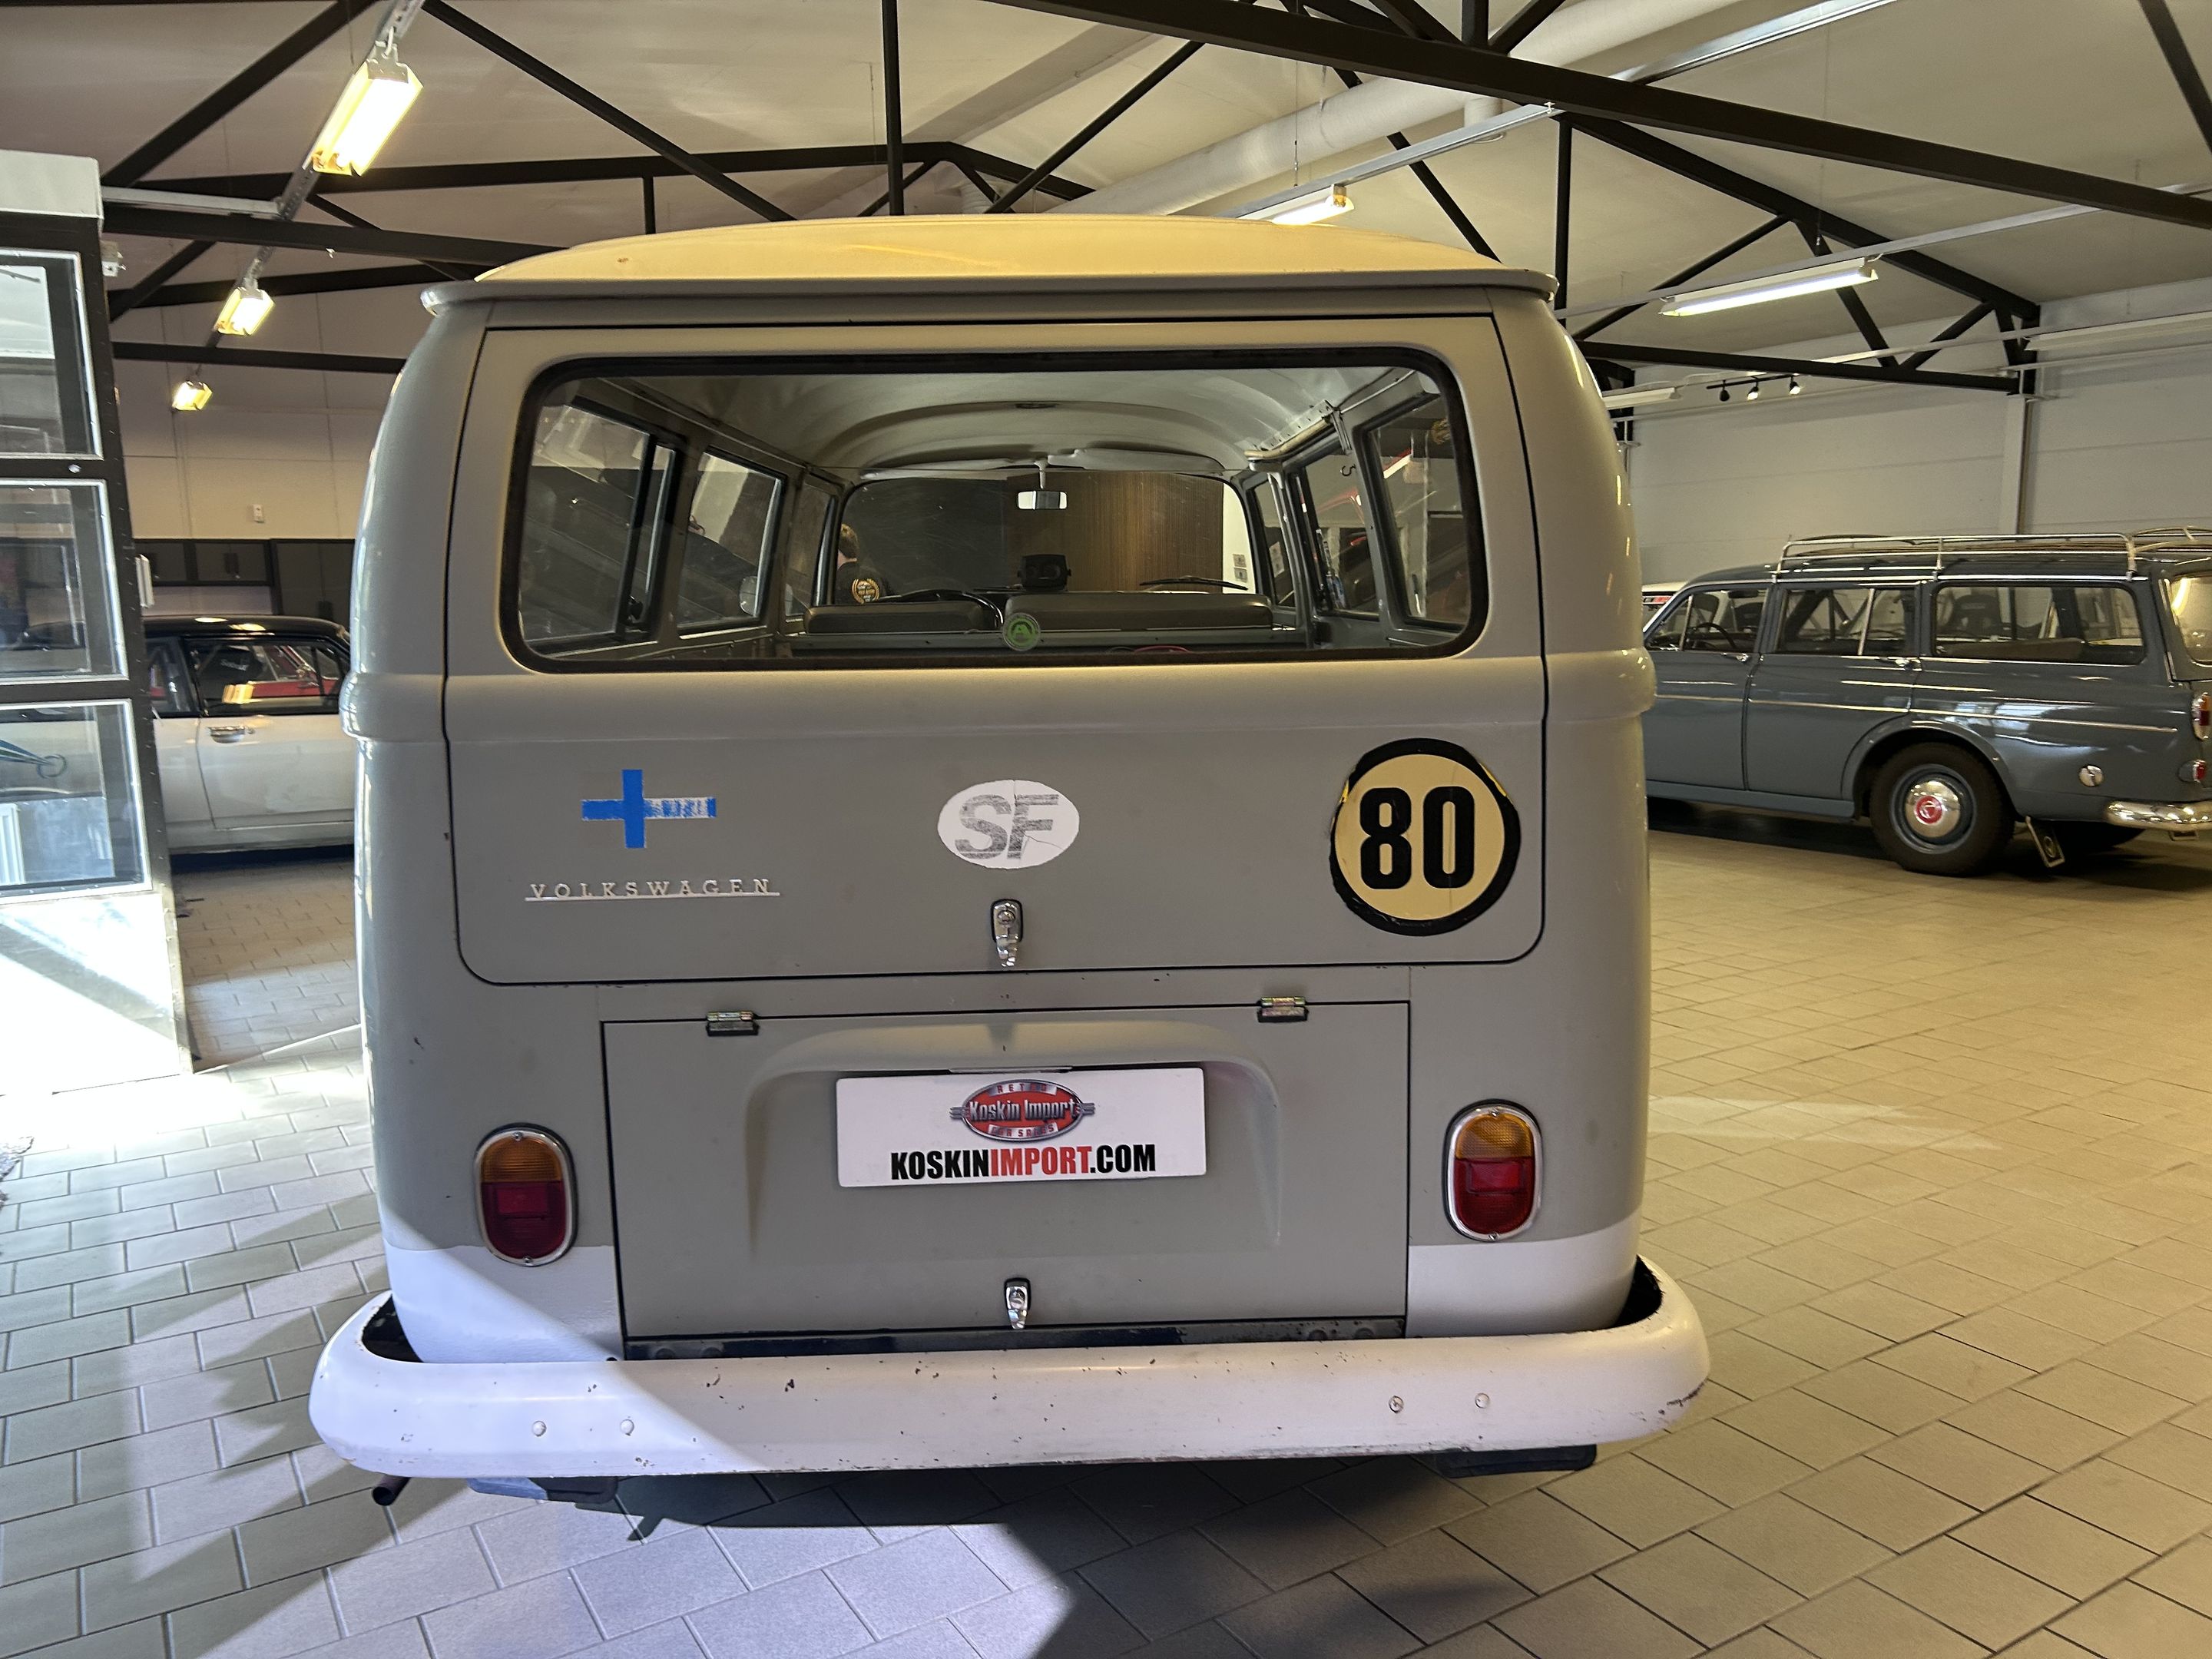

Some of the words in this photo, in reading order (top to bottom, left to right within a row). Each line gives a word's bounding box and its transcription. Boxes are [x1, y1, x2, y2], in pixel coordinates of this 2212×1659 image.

[955, 793, 1059, 859] SF
[1359, 786, 1475, 889] 80
[530, 878, 770, 898] VOLKSWAGEN
[969, 1100, 1021, 1121] Koskin
[1024, 1098, 1076, 1122] Import
[891, 1144, 1156, 1180] KOSKINIMPORT.COM
